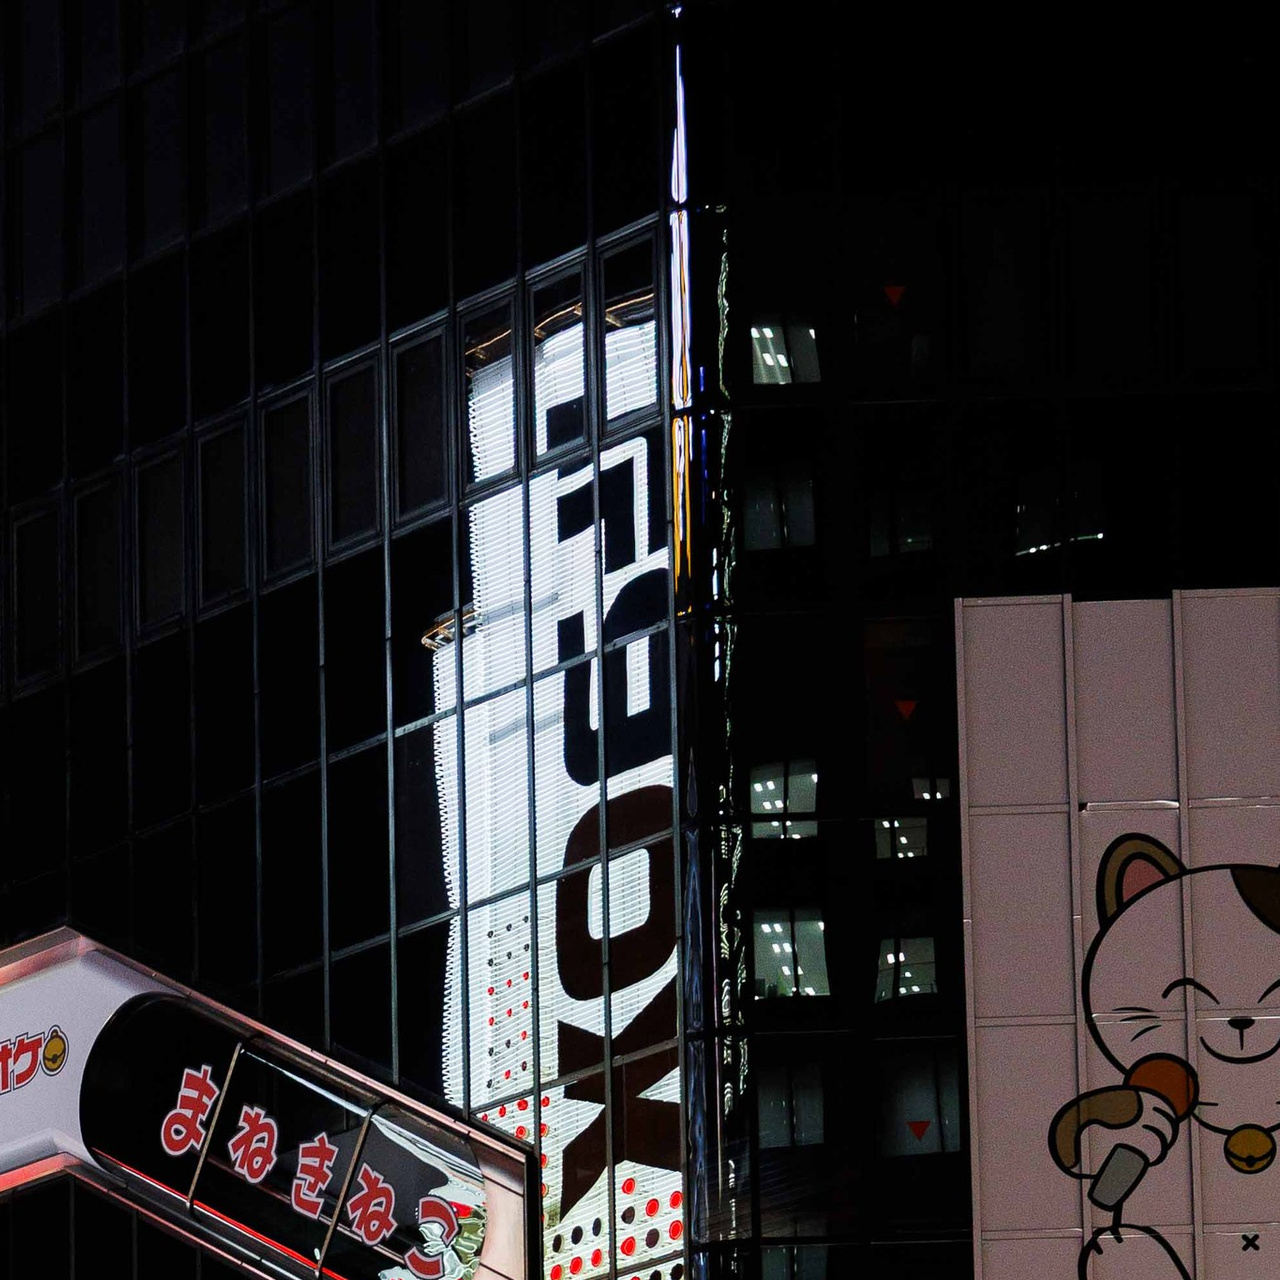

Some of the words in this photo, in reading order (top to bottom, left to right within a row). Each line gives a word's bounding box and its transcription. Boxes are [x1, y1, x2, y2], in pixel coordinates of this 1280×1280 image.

[161, 1065, 462, 1280] まねきねこ
